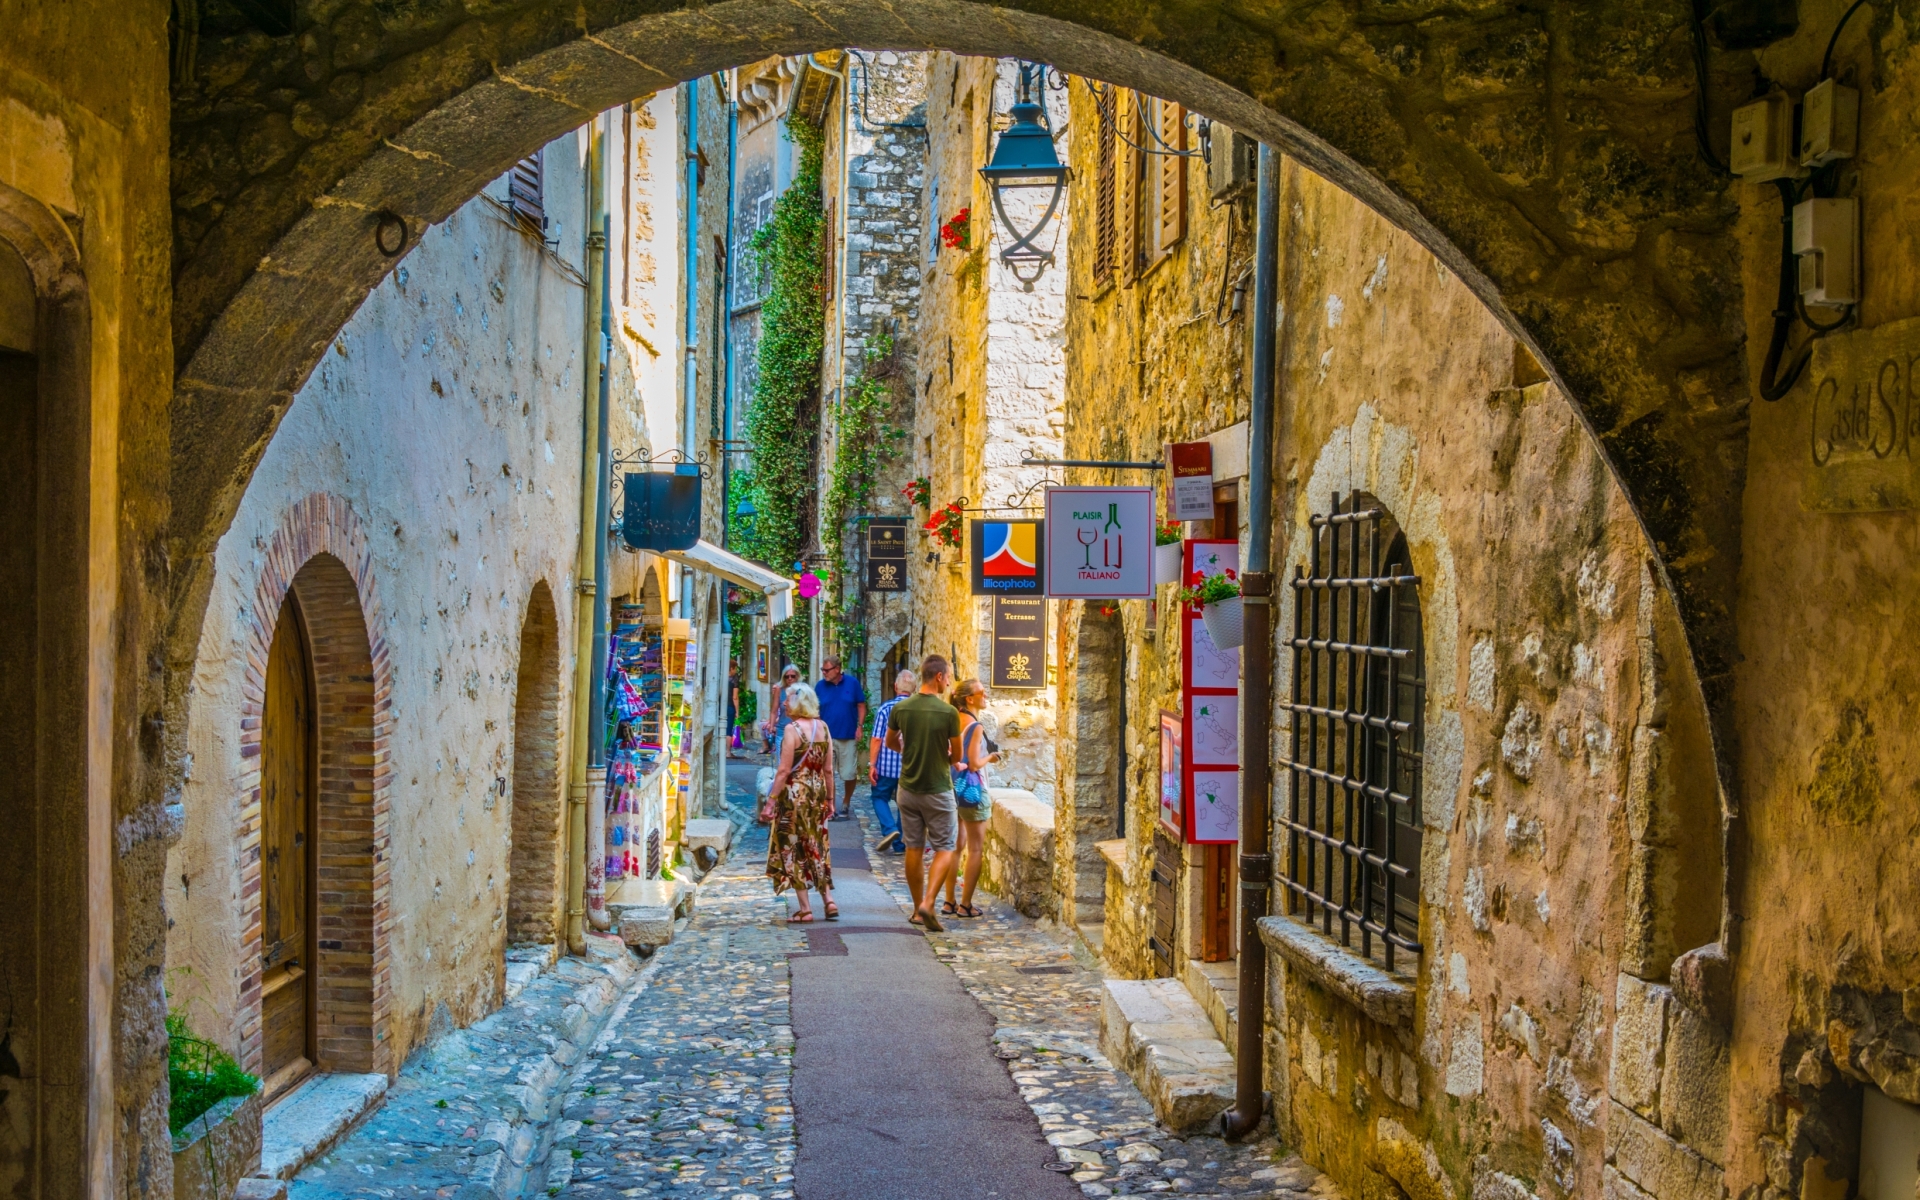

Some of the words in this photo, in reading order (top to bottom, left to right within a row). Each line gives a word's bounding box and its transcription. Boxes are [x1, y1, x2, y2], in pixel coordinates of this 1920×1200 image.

[1811, 377, 1872, 468] Castel
[1178, 465, 1207, 474] STEMMARI
[1072, 511, 1103, 520] PLAISIR
[1078, 571, 1121, 580] ITALIANO
[983, 578, 1036, 590] illicophoto
[1000, 597, 1041, 606] Restaurant
[1004, 612, 1036, 621] Terrasse
